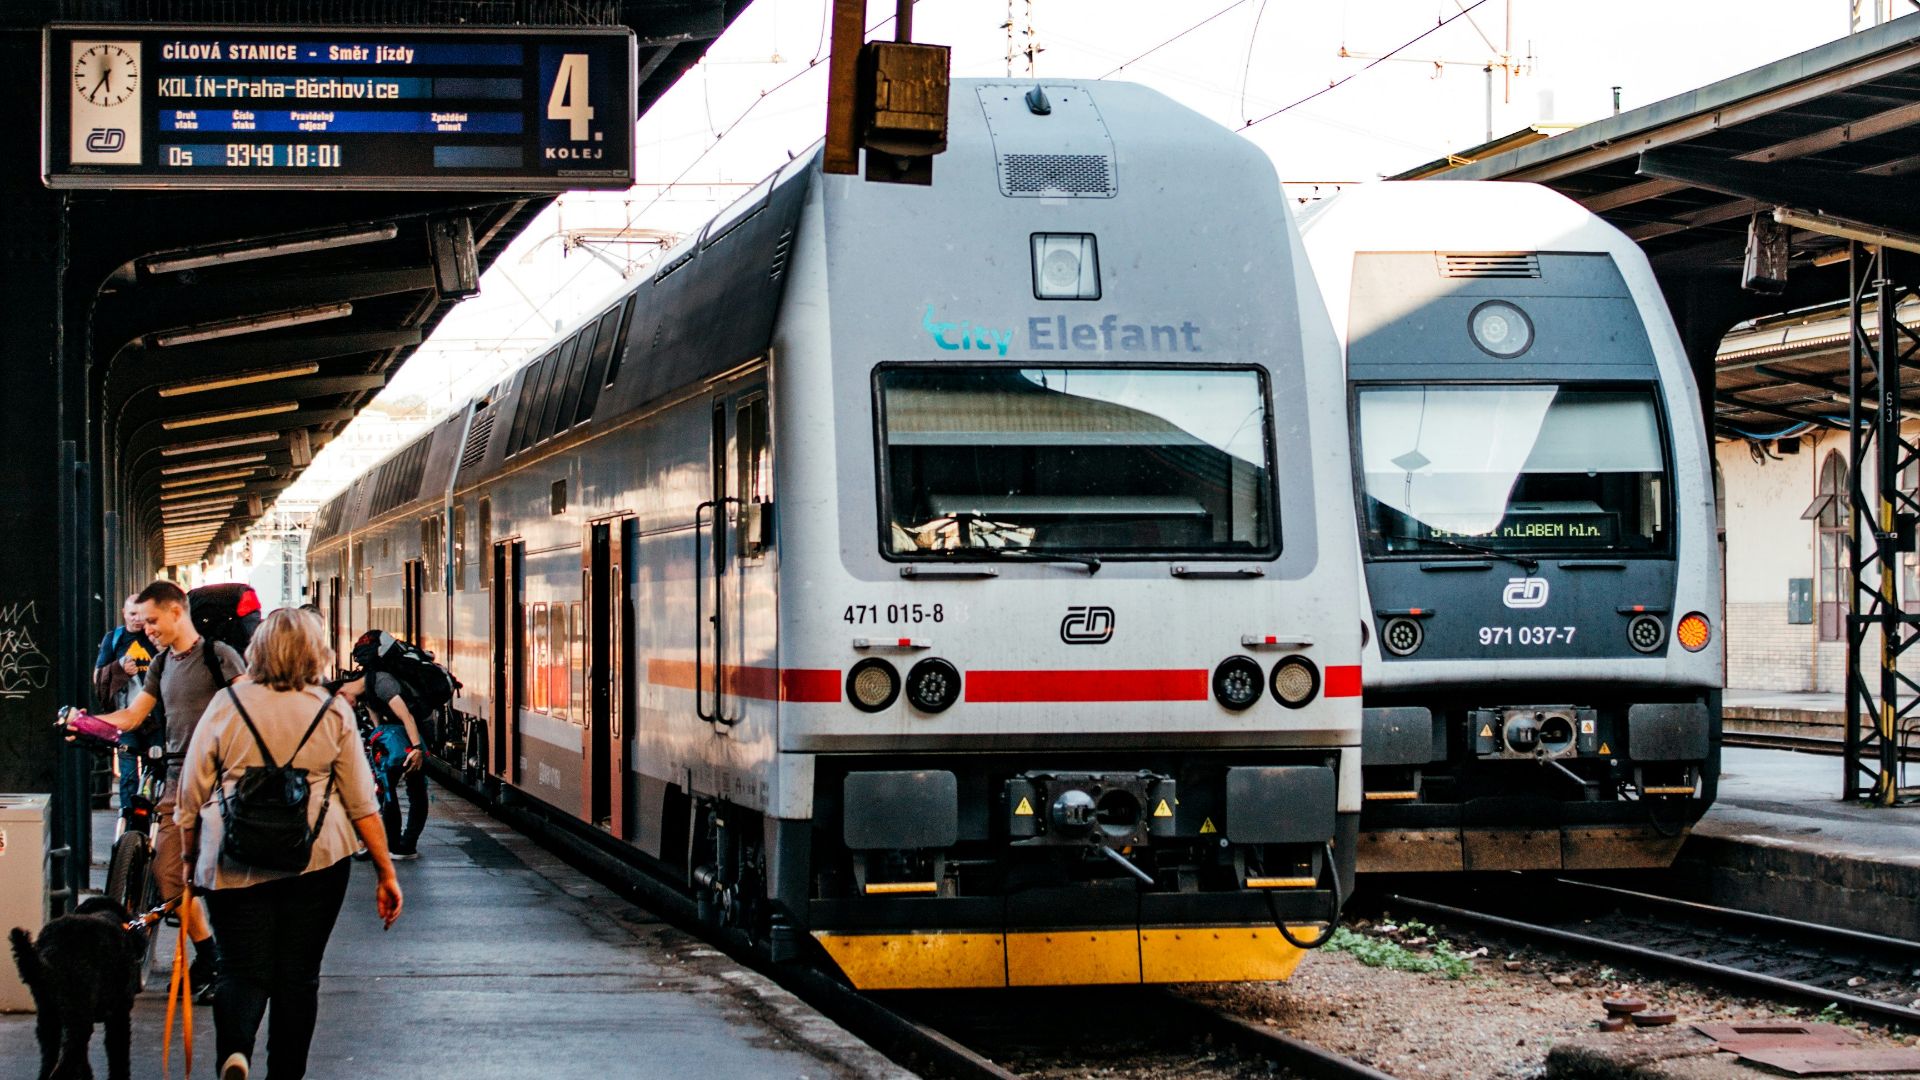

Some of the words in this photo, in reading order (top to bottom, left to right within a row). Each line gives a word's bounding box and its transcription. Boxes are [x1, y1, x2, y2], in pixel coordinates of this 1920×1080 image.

[163, 41, 221, 59] CÍLOVÁ
[229, 45, 297, 60] STANICE
[329, 46, 368, 61] Směr
[376, 46, 414, 64] jízdy
[226, 144, 274, 167] 9349
[287, 144, 341, 167] 18:01
[545, 148, 603, 159] KOLEJ
[923, 304, 1012, 357] City
[1027, 315, 1203, 351] Elefant
[843, 605, 878, 625] 471
[887, 603, 944, 624] 015-8
[1479, 626, 1512, 645] 971
[1519, 626, 1576, 645] 037-7
